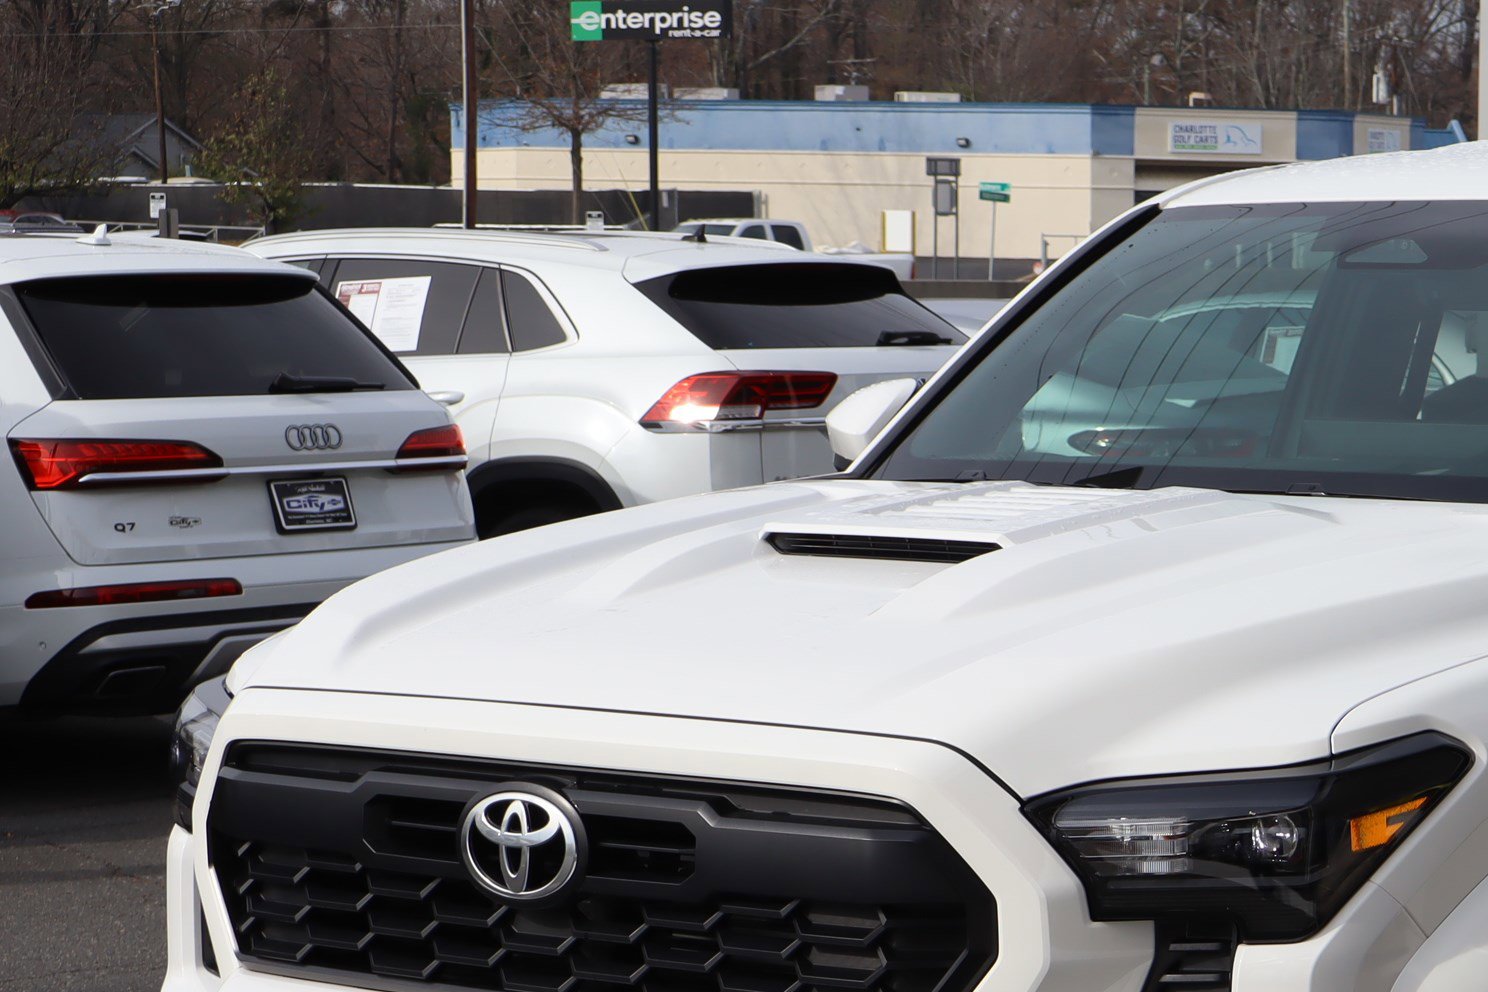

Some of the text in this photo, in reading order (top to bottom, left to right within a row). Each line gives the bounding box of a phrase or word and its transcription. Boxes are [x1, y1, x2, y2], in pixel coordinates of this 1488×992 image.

[571, 6, 721, 34] enterprise
[668, 29, 721, 38] rent-a-car
[1173, 124, 1217, 134] CHARLOTTE
[1173, 135, 1218, 144] GOLF CARTS
[113, 522, 136, 533] Q7
